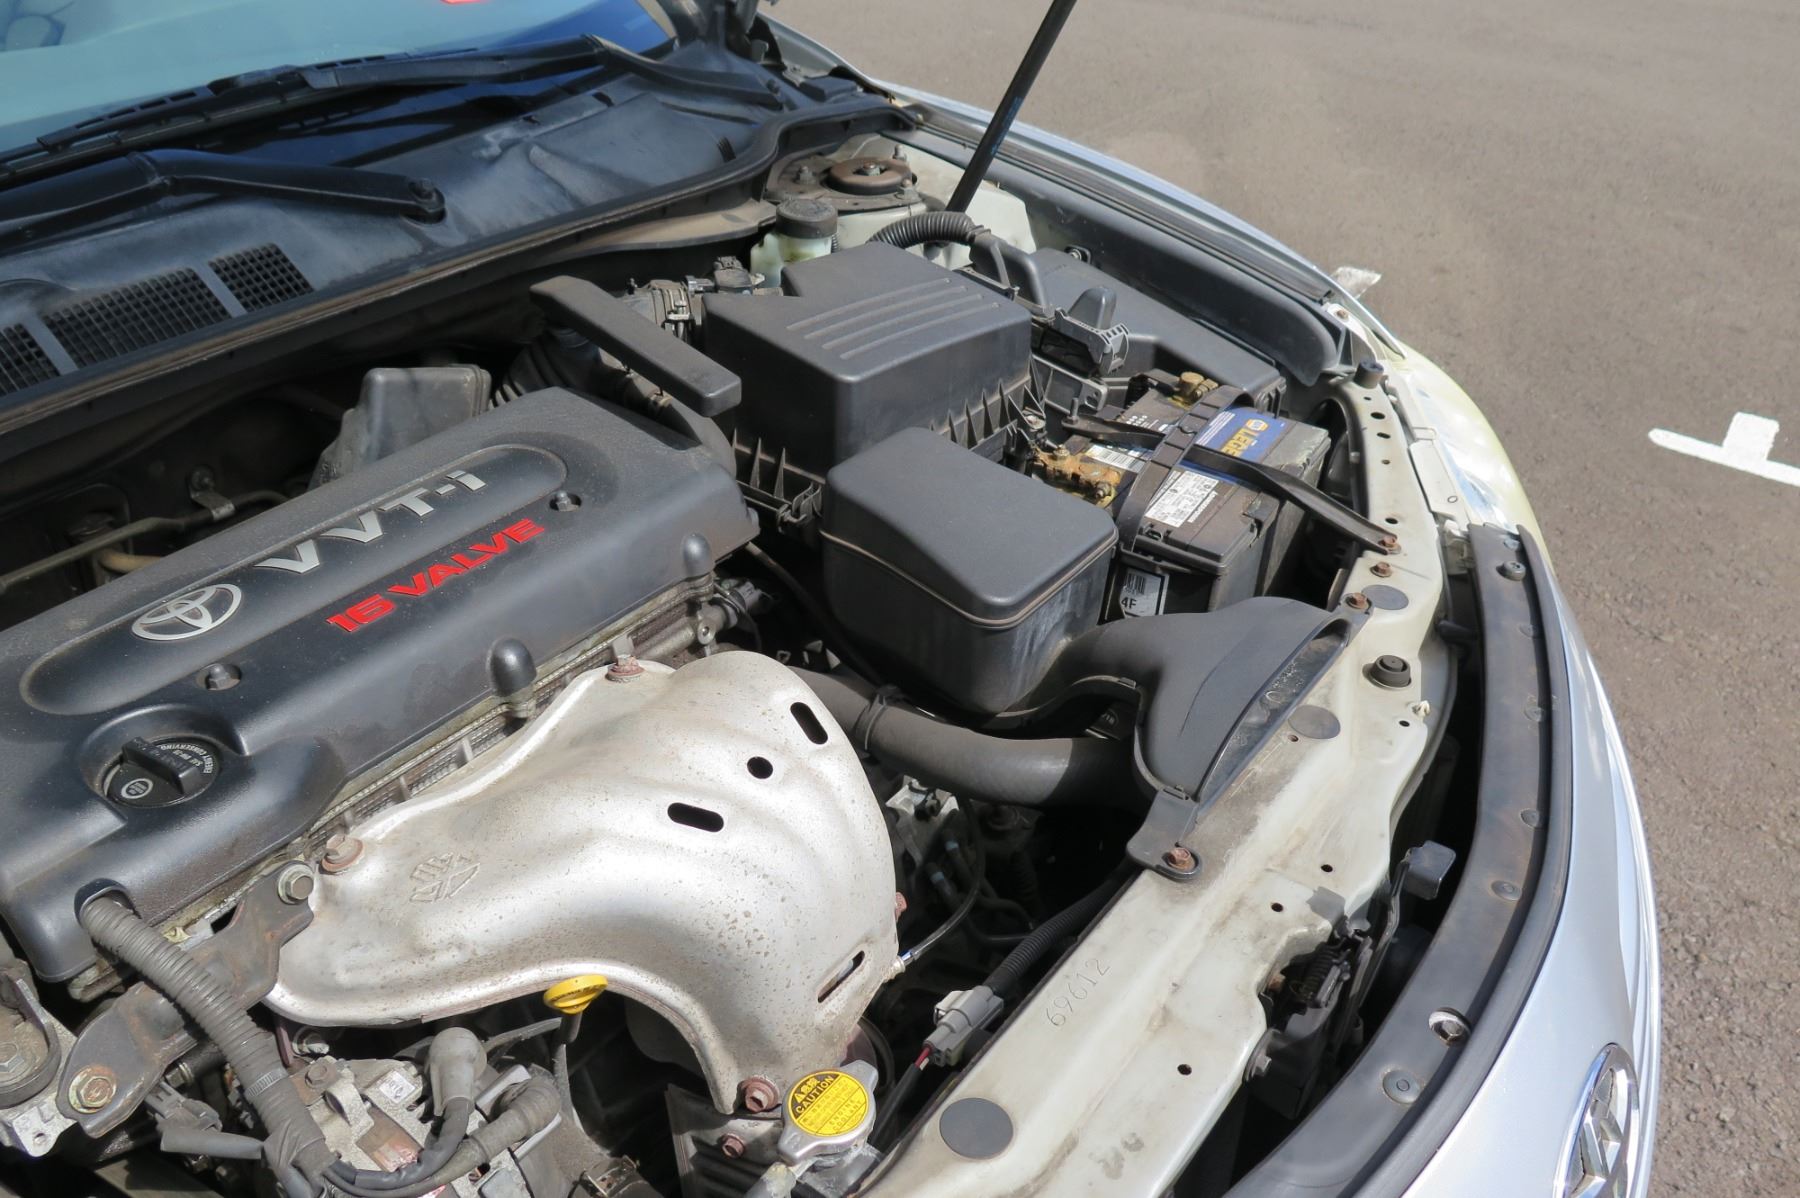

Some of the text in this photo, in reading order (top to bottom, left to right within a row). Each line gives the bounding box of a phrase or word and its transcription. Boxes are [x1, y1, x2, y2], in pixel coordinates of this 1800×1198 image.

[1220, 426, 1261, 458] LEGE
[252, 469, 487, 574] VVT-i
[326, 518, 545, 632] 16 VALVE
[1046, 958, 1111, 1027] 69612
[795, 1075, 835, 1114] CAUTION
